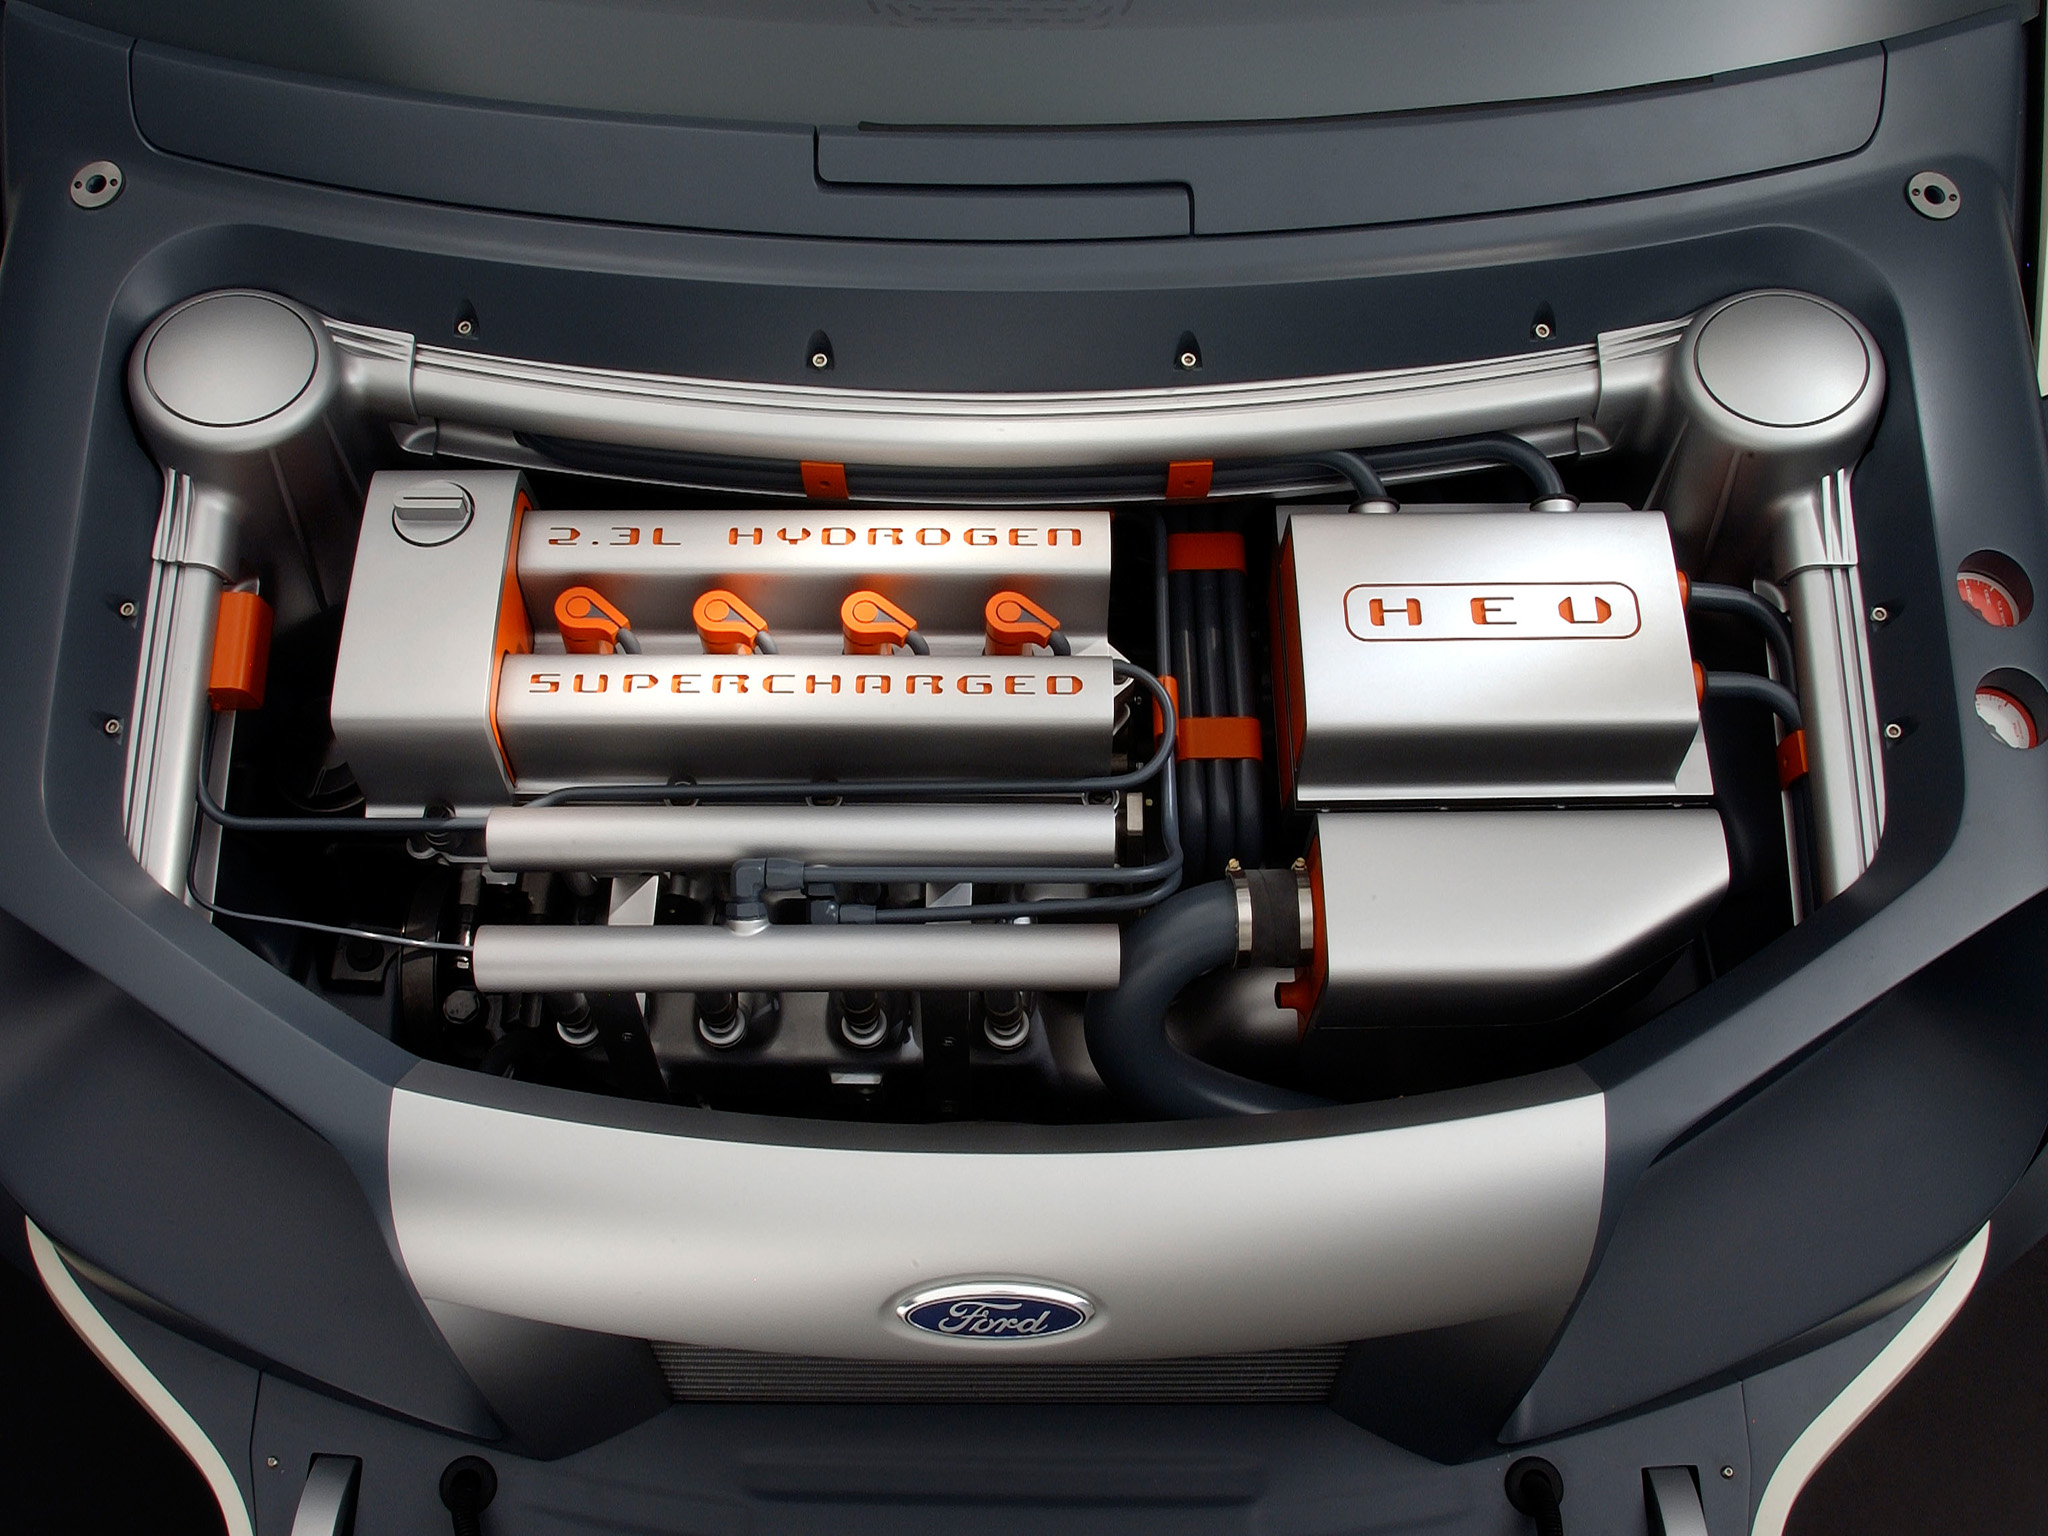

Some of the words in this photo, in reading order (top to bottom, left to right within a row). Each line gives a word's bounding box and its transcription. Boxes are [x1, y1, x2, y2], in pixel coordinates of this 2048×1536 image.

[548, 527, 682, 547] 2.3L
[728, 527, 1083, 547] HYDROGEN
[529, 673, 1084, 695] SUPERCHARGED
[938, 1301, 1050, 1334] Ford
